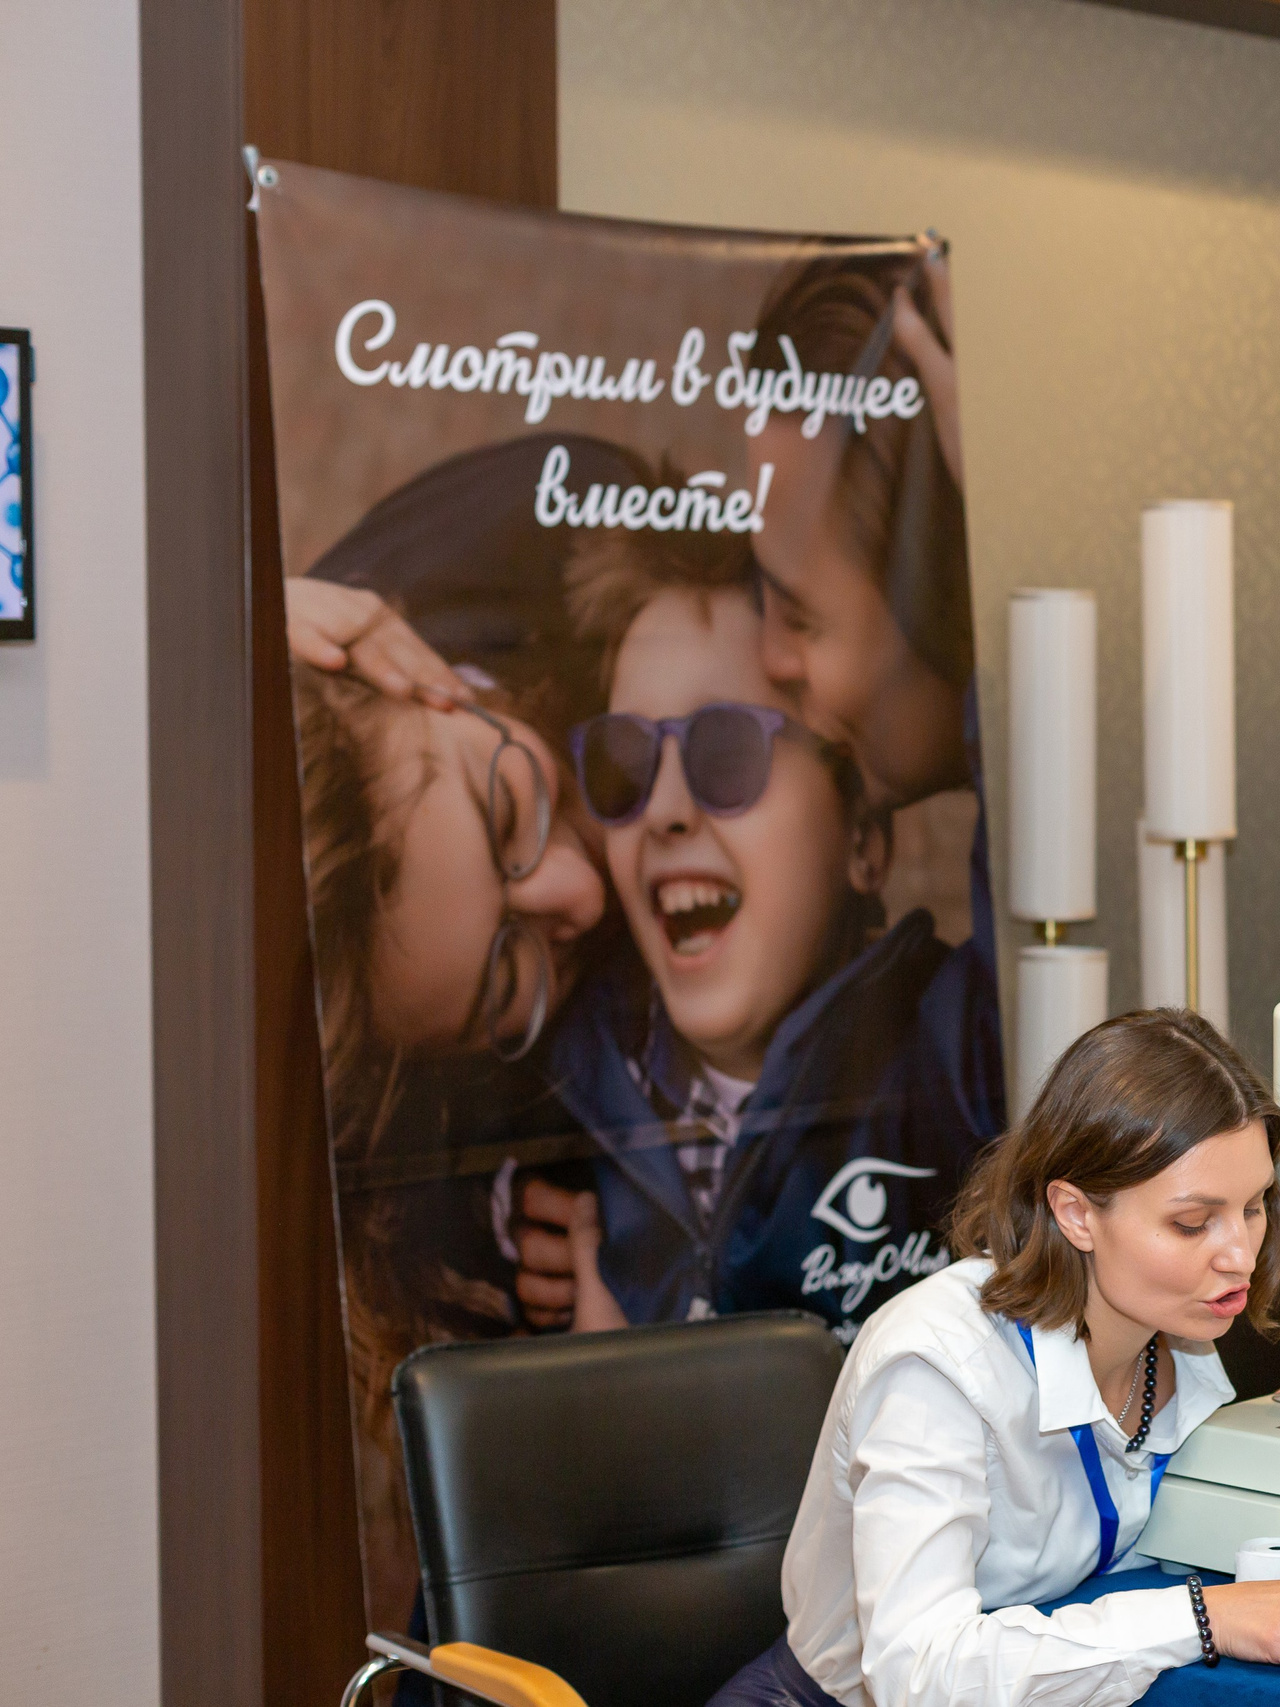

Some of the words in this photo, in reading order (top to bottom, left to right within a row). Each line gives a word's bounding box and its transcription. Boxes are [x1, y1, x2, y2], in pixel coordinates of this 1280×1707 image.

[335, 299, 664, 424] Смотрим
[671, 327, 710, 405] в
[716, 331, 926, 438] будущее
[535, 446, 774, 533] вместе!
